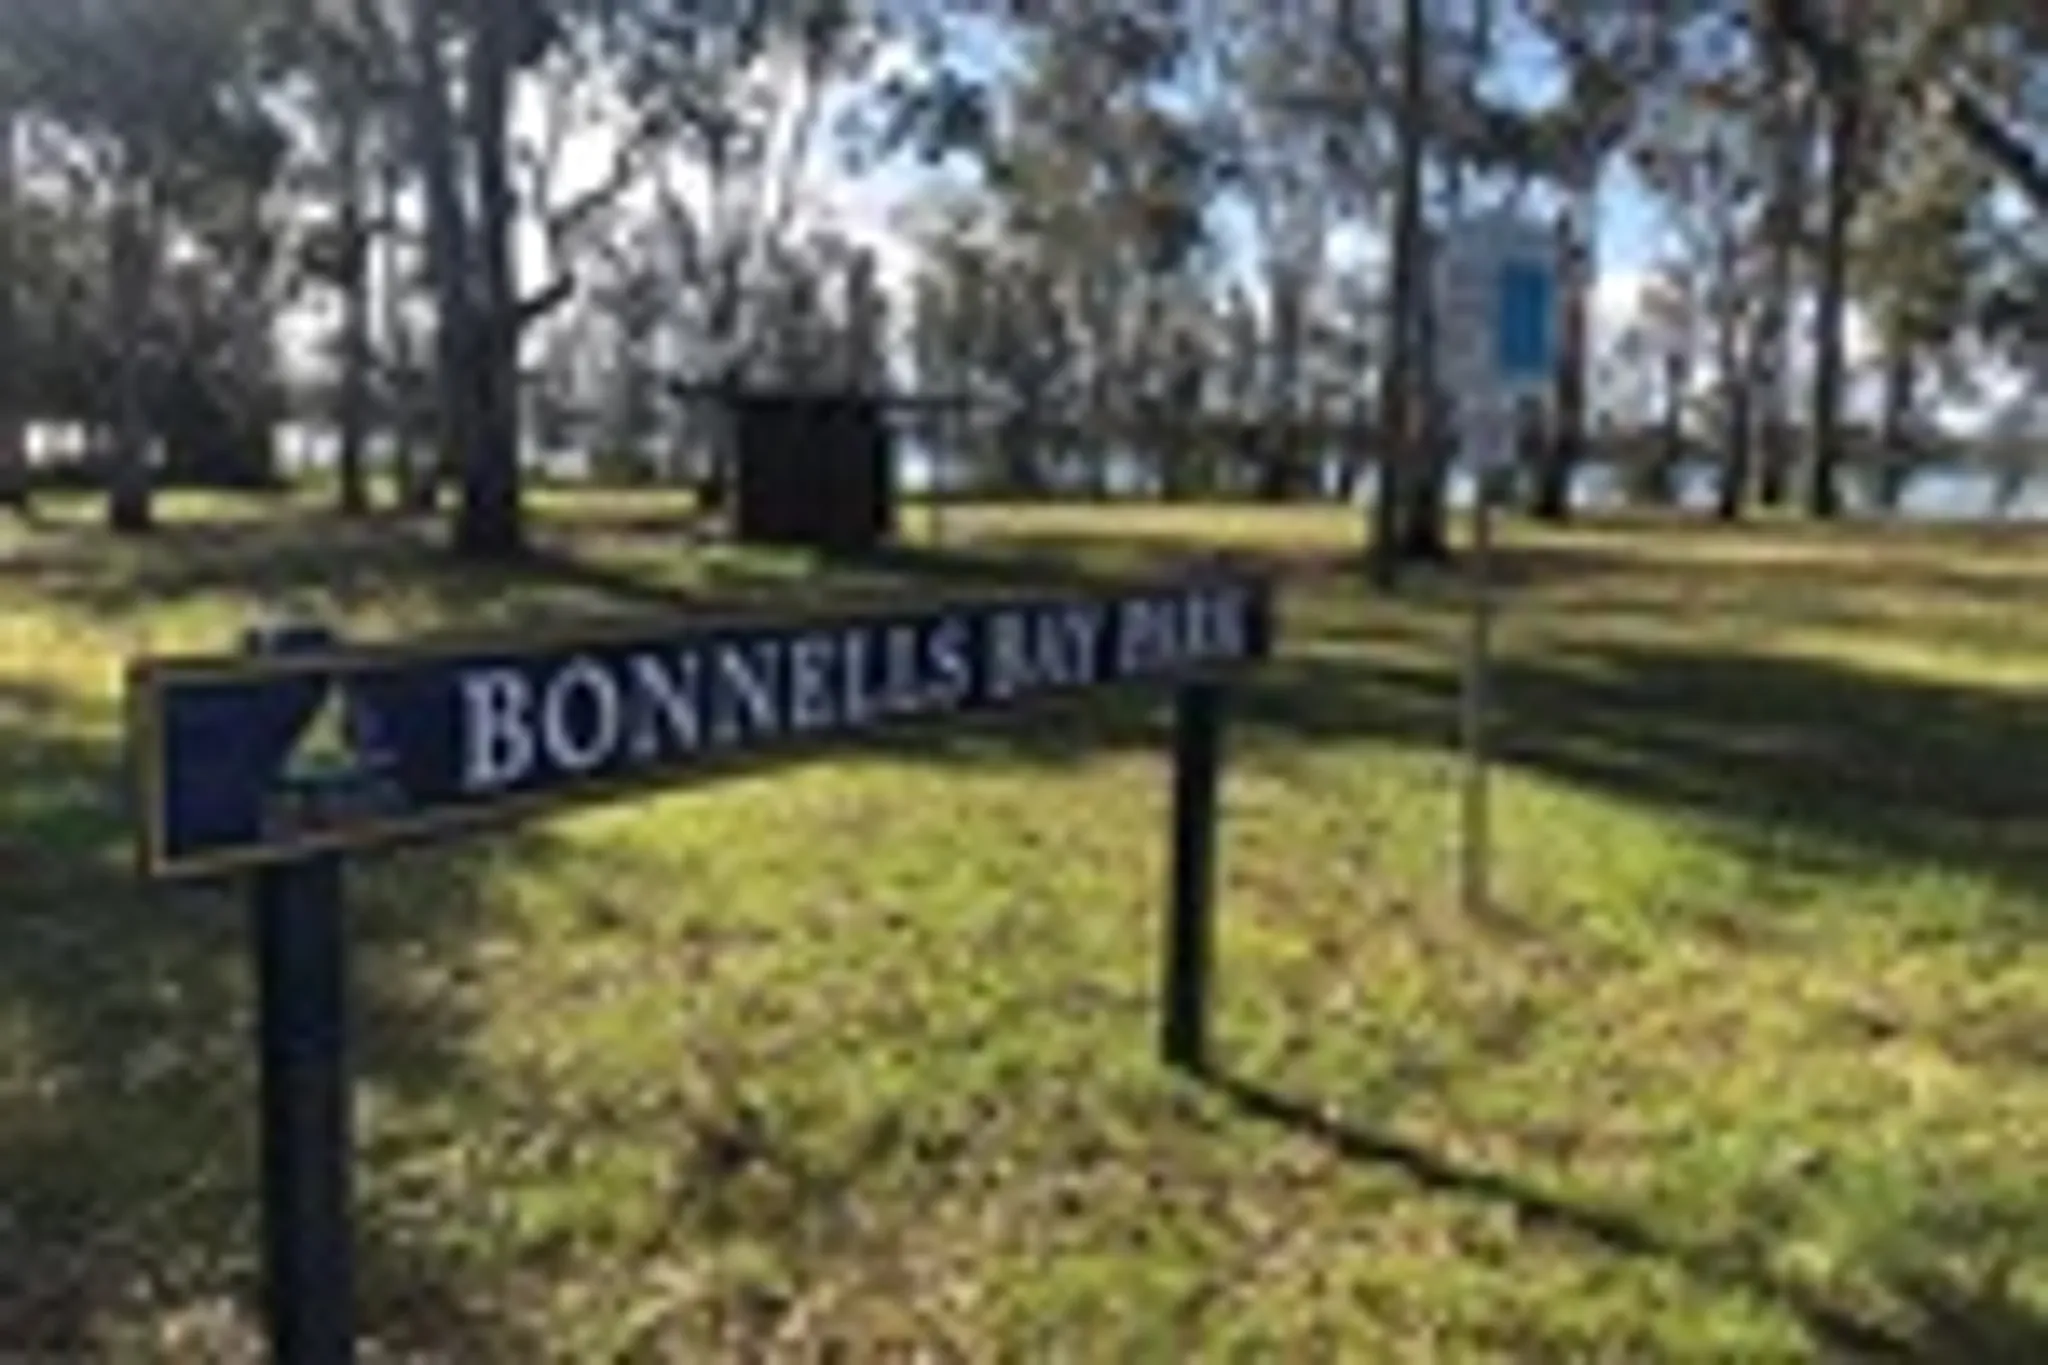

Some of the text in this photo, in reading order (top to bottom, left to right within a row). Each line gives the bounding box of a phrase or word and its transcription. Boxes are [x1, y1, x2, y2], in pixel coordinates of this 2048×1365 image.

[462, 590, 1247, 790] BONNELLS BAY PARK
